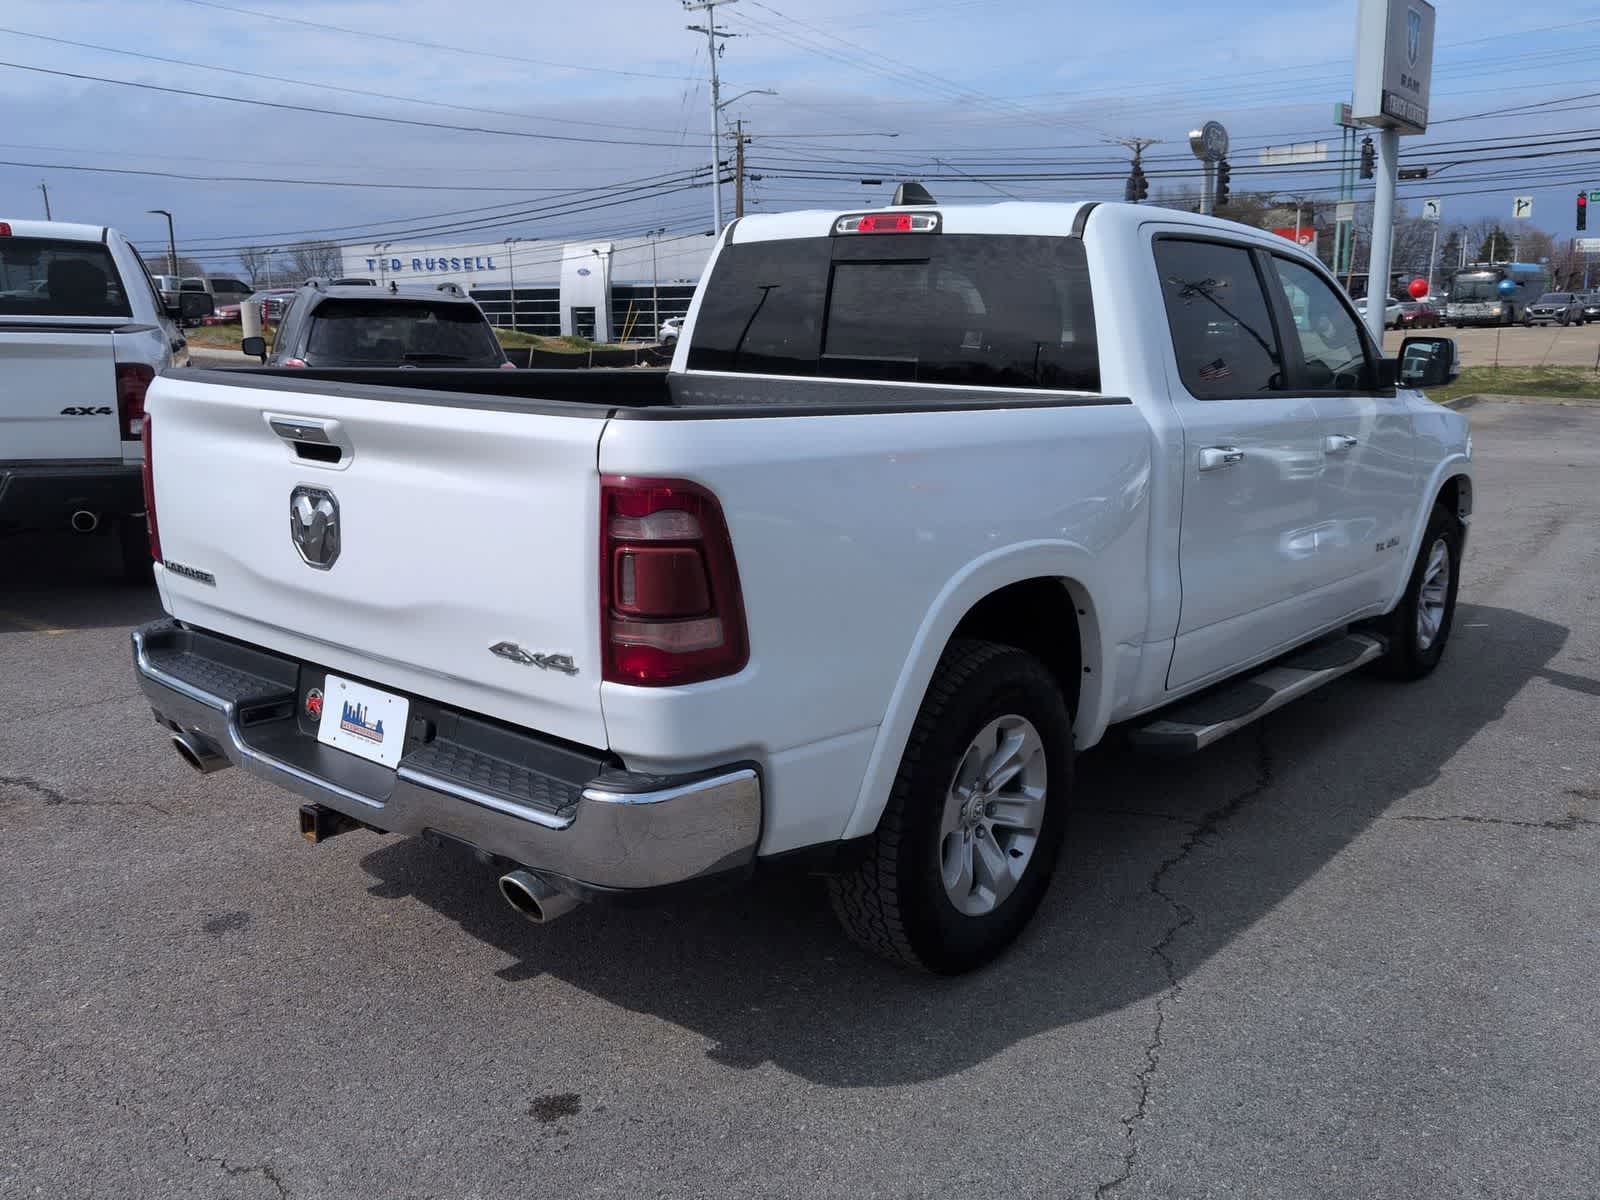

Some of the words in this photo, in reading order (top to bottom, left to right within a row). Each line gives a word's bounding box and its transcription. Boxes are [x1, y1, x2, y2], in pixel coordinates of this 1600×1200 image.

[1400, 73, 1420, 94] RAM
[366, 257, 401, 272] TED
[412, 256, 496, 270] RUSSELL
[164, 560, 214, 585] LARAMIE
